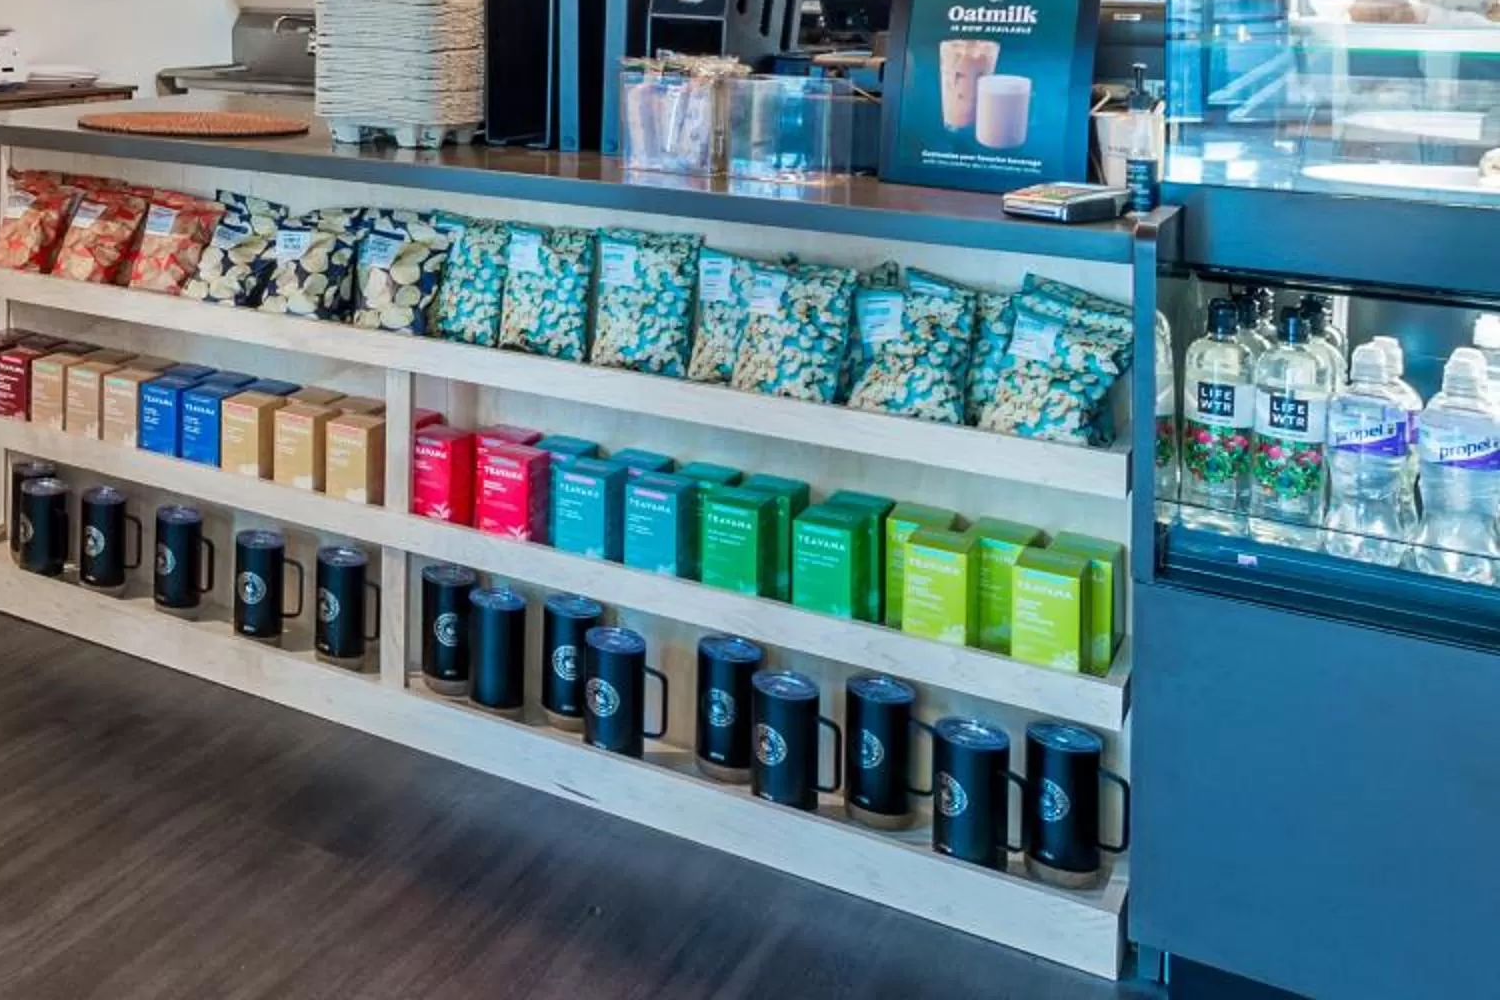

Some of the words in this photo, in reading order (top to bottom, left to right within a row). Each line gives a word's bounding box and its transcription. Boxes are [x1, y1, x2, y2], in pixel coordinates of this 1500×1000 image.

[948, 5, 1039, 24] Oatmilk
[1201, 387, 1232, 400] LIFE
[1273, 401, 1305, 414] LIFE
[1273, 413, 1305, 427] WTR
[1439, 438, 1491, 460] propel
[707, 512, 753, 529] TEAVANA
[797, 534, 846, 553] TEAVANA
